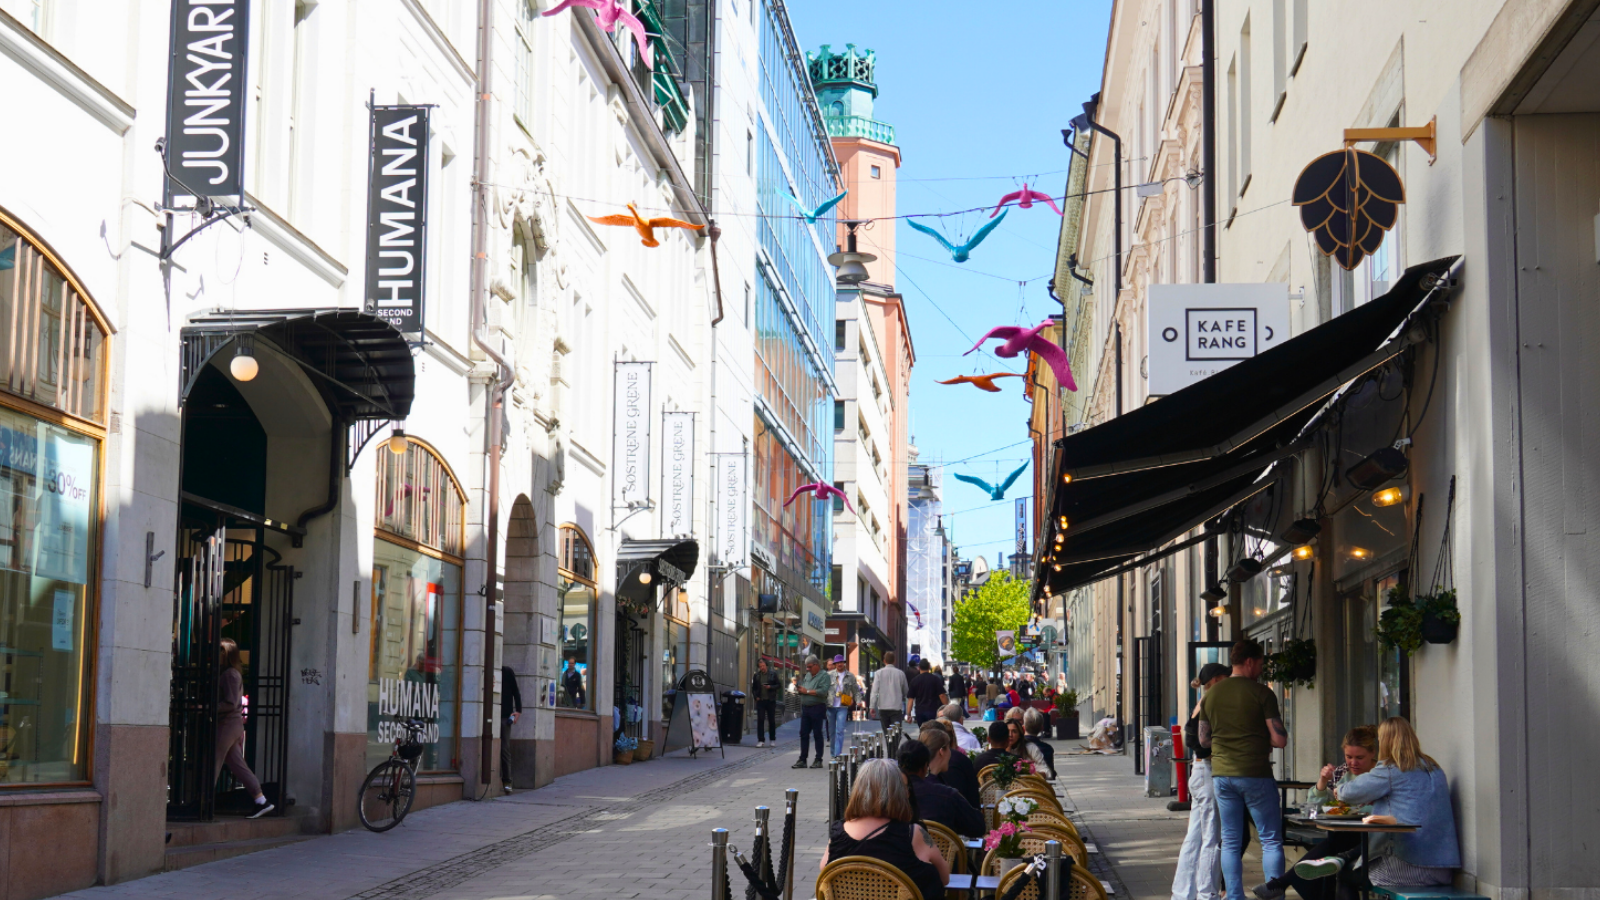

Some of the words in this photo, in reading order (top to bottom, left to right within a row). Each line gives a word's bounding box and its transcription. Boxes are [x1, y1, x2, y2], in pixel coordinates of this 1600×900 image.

[182, 0, 235, 185] JUNKYAR
[377, 115, 418, 307] HUMANA
[377, 309, 413, 317] SECOND
[1198, 320, 1246, 332] KAFE
[1198, 336, 1246, 349] RANG
[626, 371, 640, 417] GRENE
[626, 420, 640, 492] SØSTRENE
[673, 421, 684, 462] GRENE
[48, 468, 76, 497] 30%
[672, 464, 684, 526] SØSTRENE
[727, 461, 738, 496] GRENE
[379, 677, 439, 718] HUMANA
